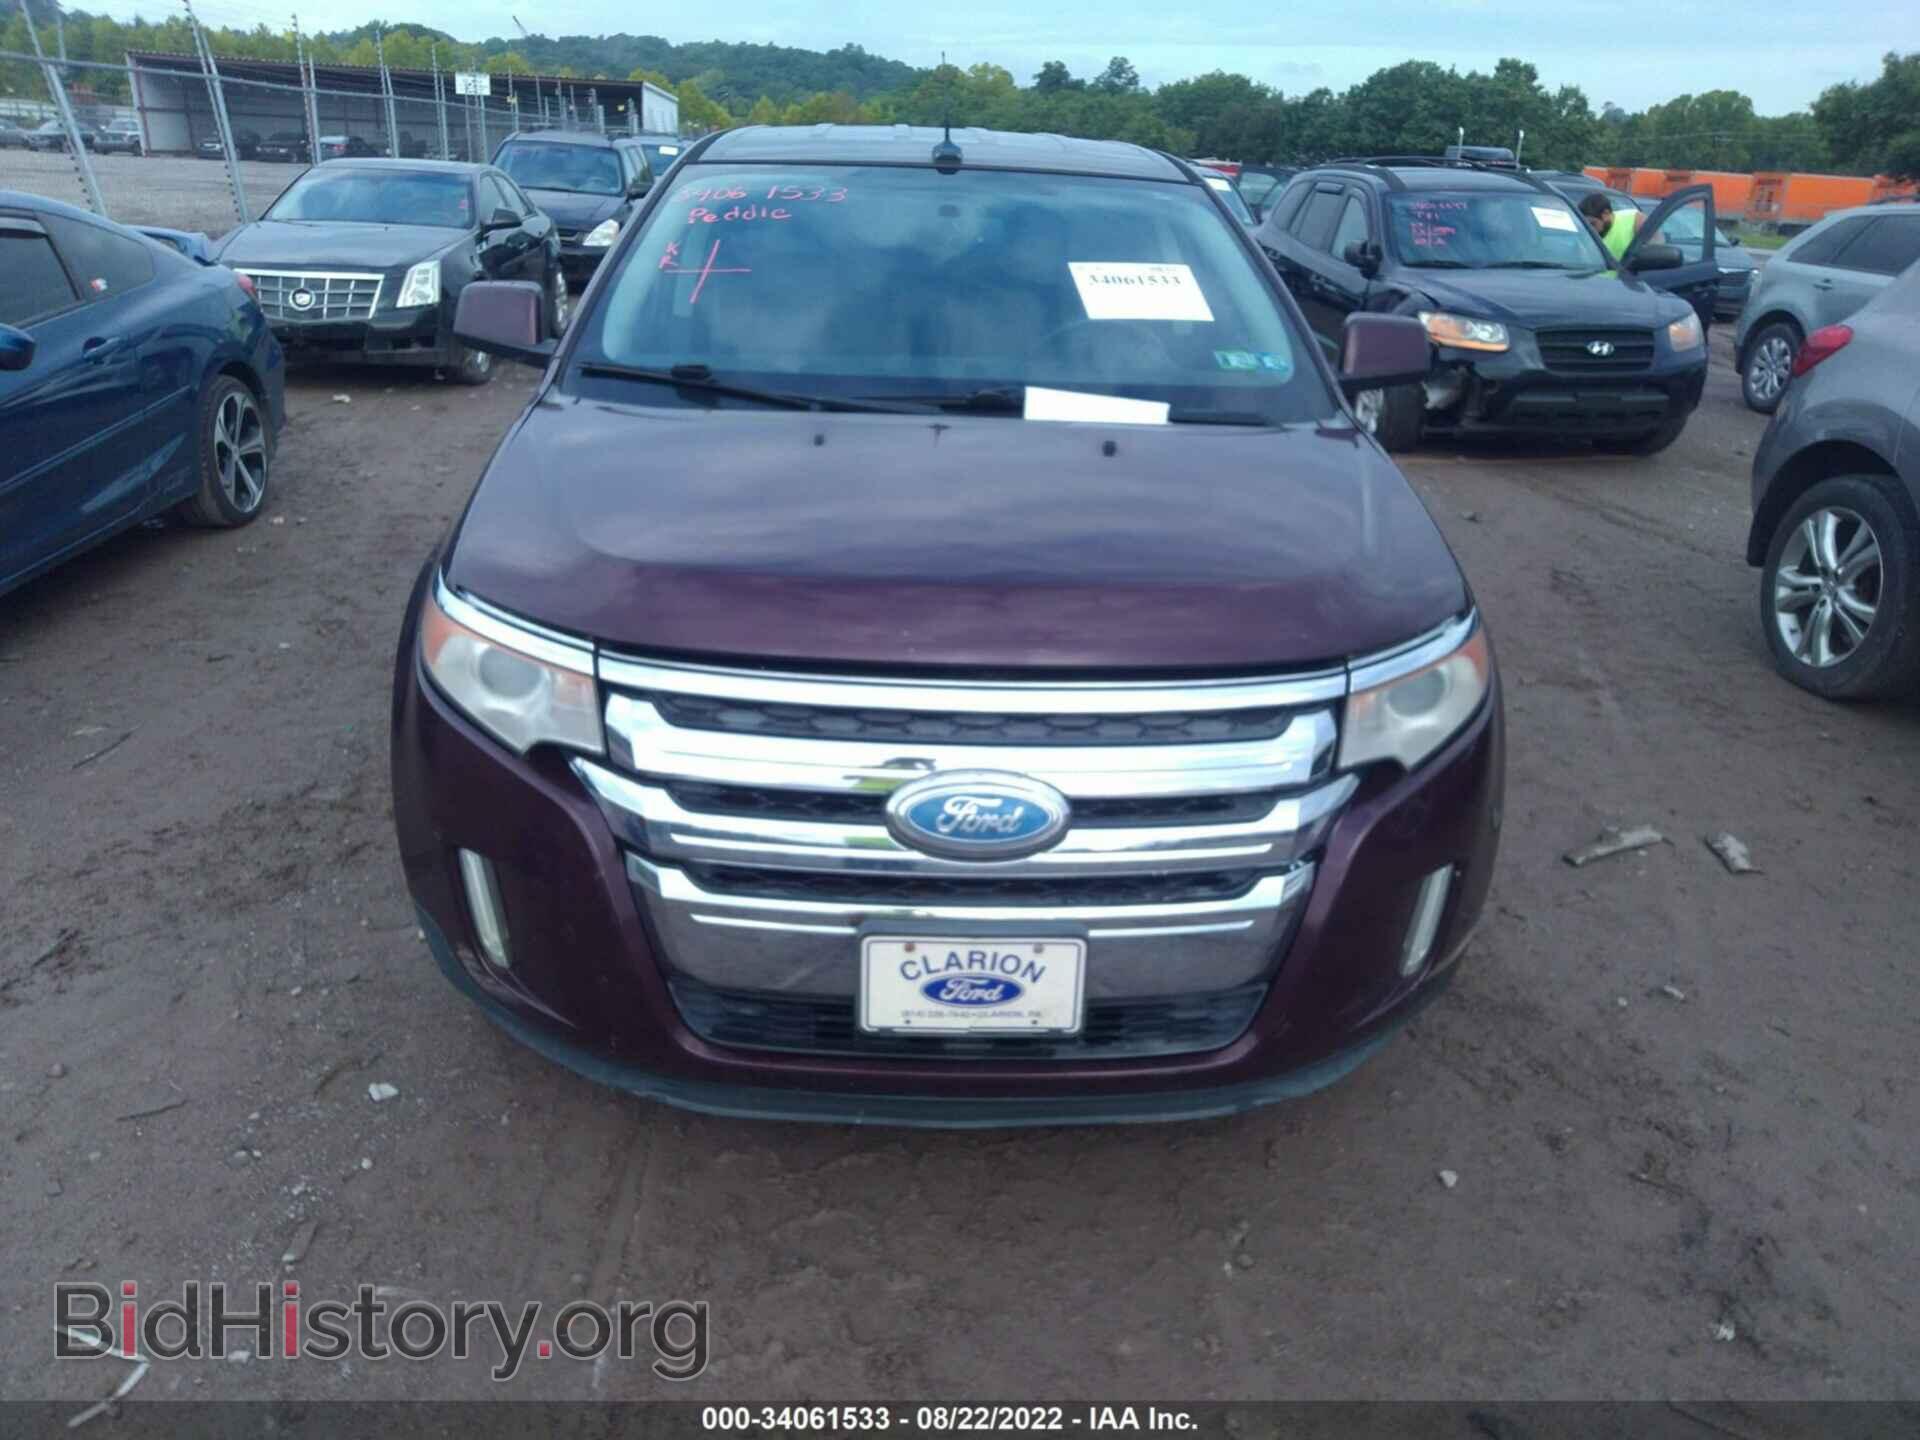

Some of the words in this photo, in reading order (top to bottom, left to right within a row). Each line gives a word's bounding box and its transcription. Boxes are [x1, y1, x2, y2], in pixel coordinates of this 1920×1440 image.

[936, 795, 1025, 833] Ford
[900, 950, 1046, 984] CLARION
[938, 977, 1004, 1002] Ford
